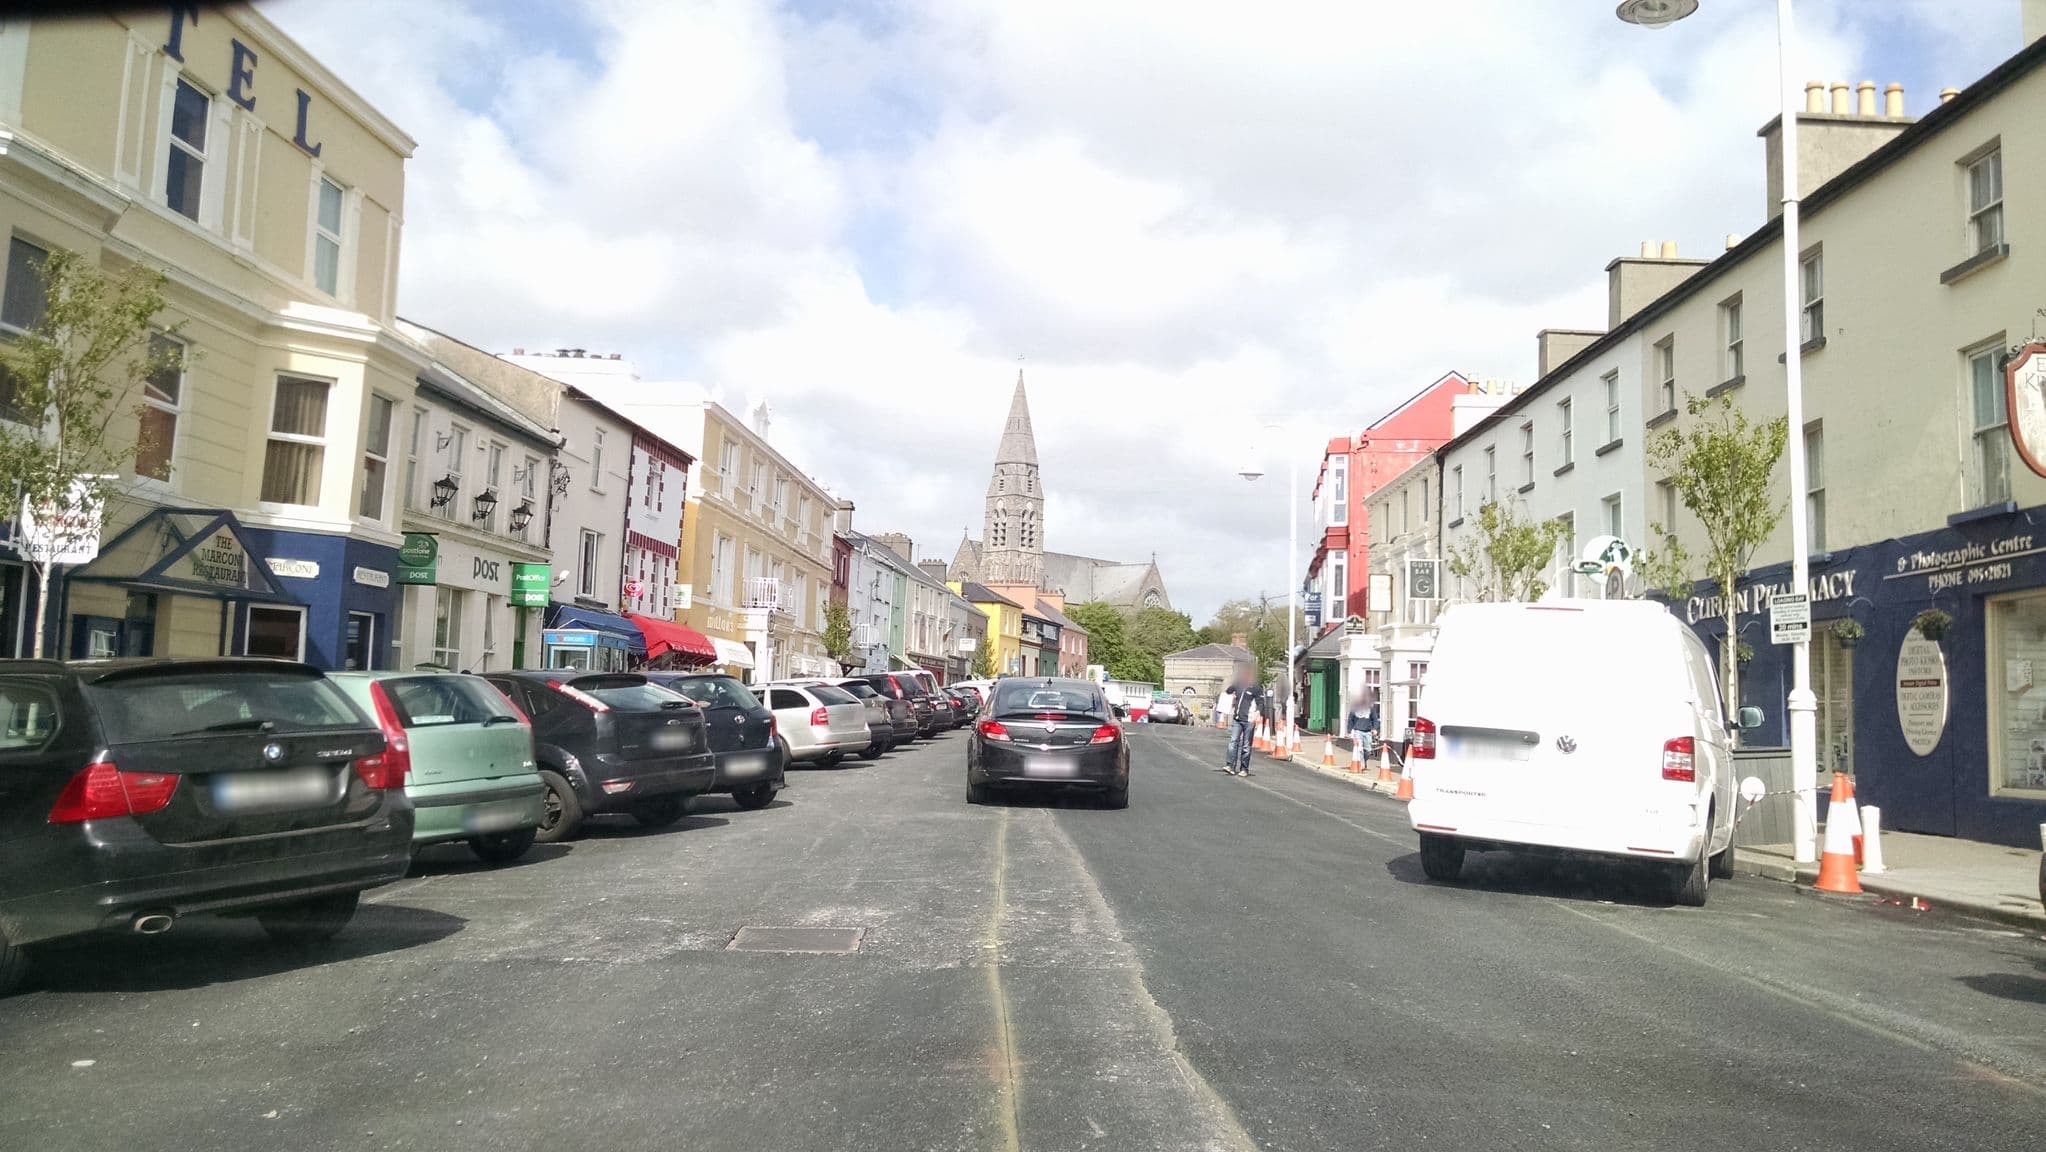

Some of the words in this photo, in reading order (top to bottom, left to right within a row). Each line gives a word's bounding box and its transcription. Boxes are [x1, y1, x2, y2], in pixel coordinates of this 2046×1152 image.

[216, 535, 233, 550] THE
[1911, 541, 1986, 570] Photographic
[1991, 535, 2033, 555] Centre
[1928, 571, 1963, 589] PHONE
[1436, 787, 1487, 797] TRANSPORTER
